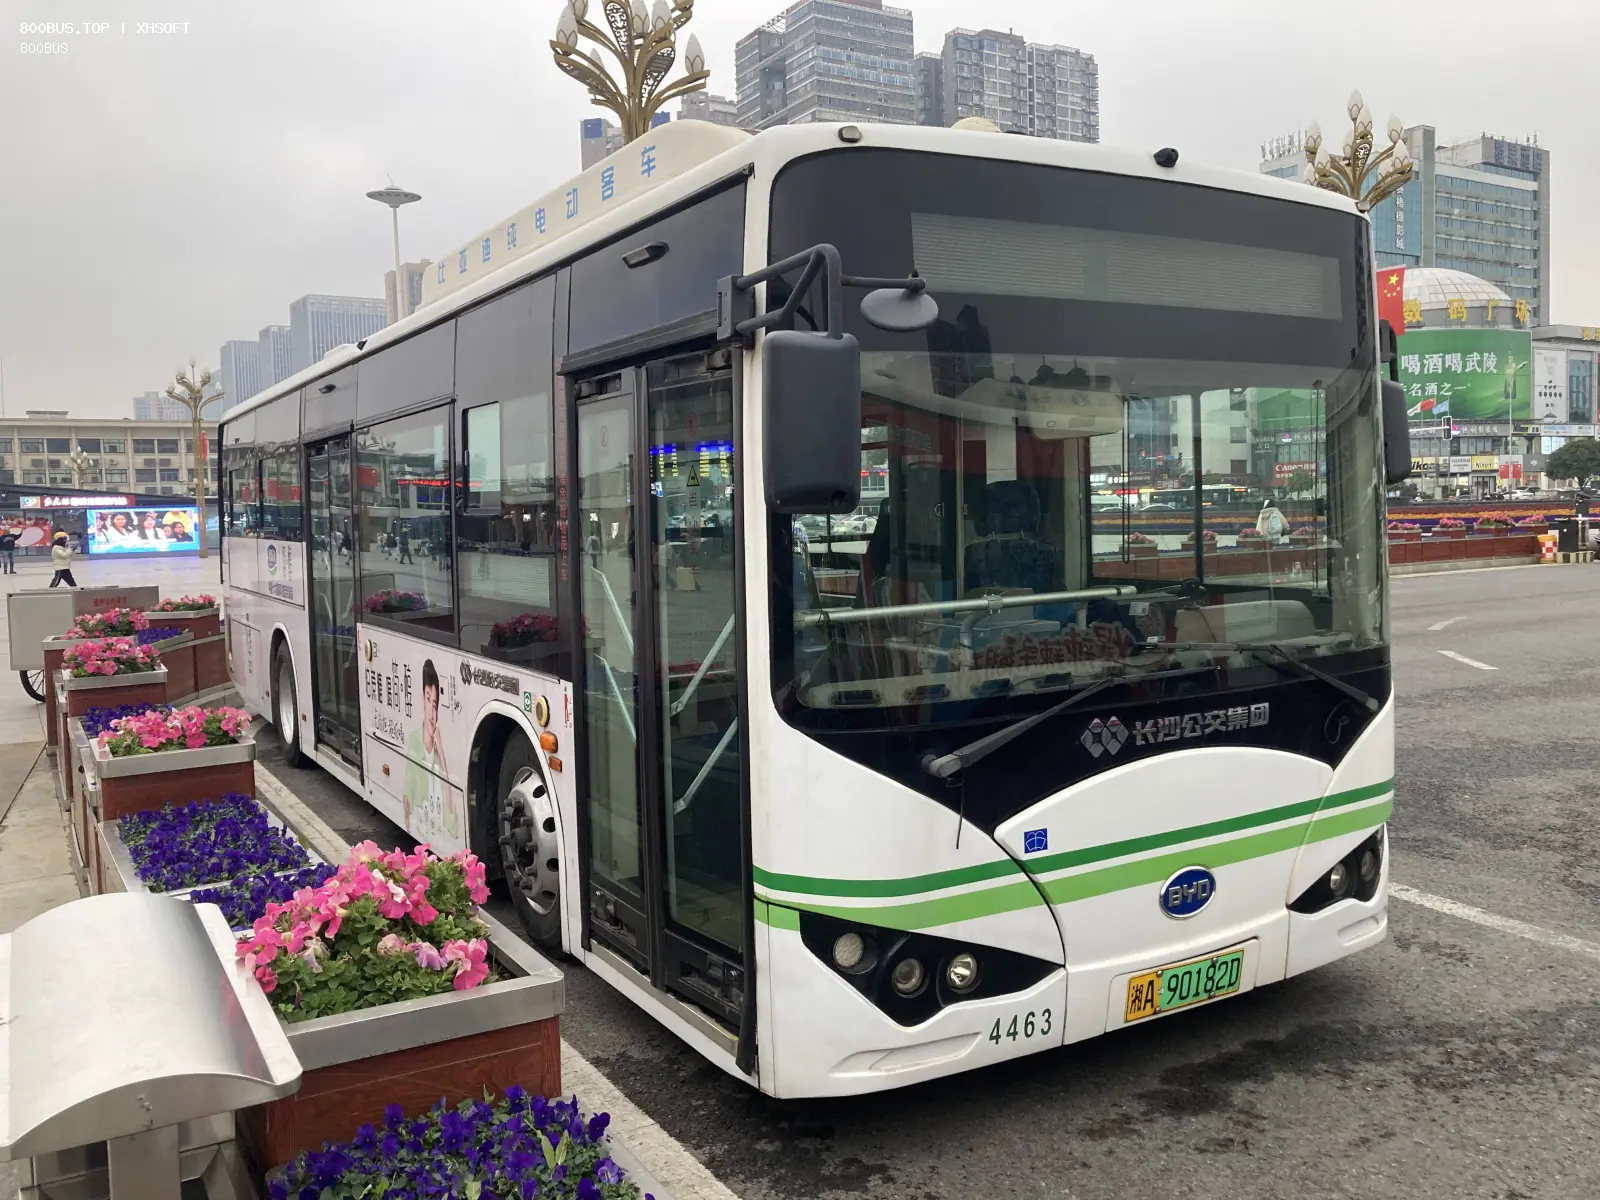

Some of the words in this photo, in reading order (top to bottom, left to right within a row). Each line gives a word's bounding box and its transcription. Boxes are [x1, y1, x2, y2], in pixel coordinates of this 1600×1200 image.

[437, 145, 656, 284] 比亚迪纯电动客车
[1401, 352, 1498, 376] 喝酒喝武陵
[1132, 702, 1270, 746] 长沙公交集团
[1168, 879, 1211, 908] BYD
[1129, 979, 1155, 1015] 湘A
[1165, 957, 1242, 1005] 90182D
[988, 1007, 1053, 1045] 4463
